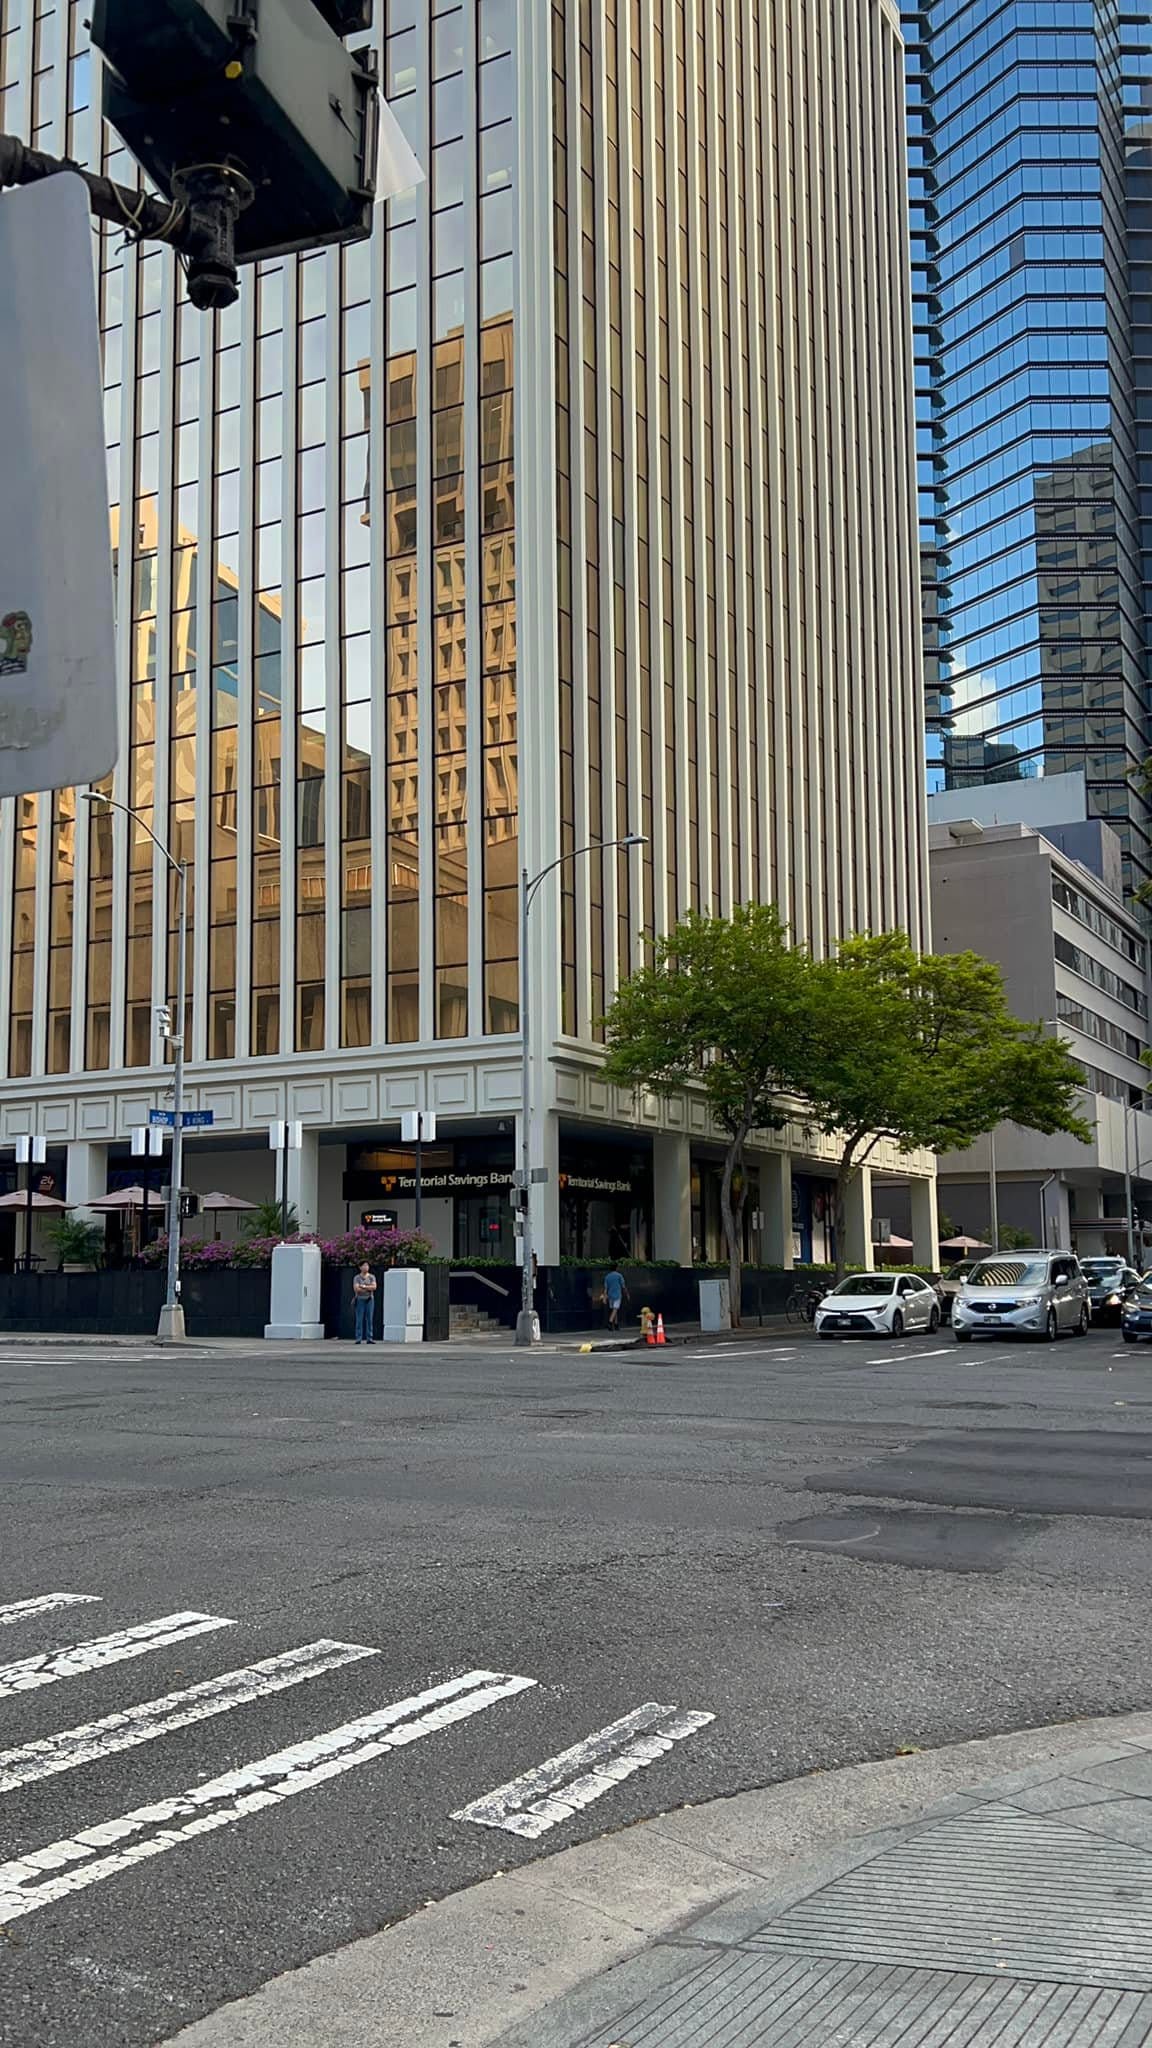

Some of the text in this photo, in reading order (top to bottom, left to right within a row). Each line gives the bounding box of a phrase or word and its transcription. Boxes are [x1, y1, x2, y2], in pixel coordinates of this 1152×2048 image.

[398, 1172, 513, 1188] Terrtorial Savings Ban
[567, 1175, 631, 1192] Territorial Savings Bank
